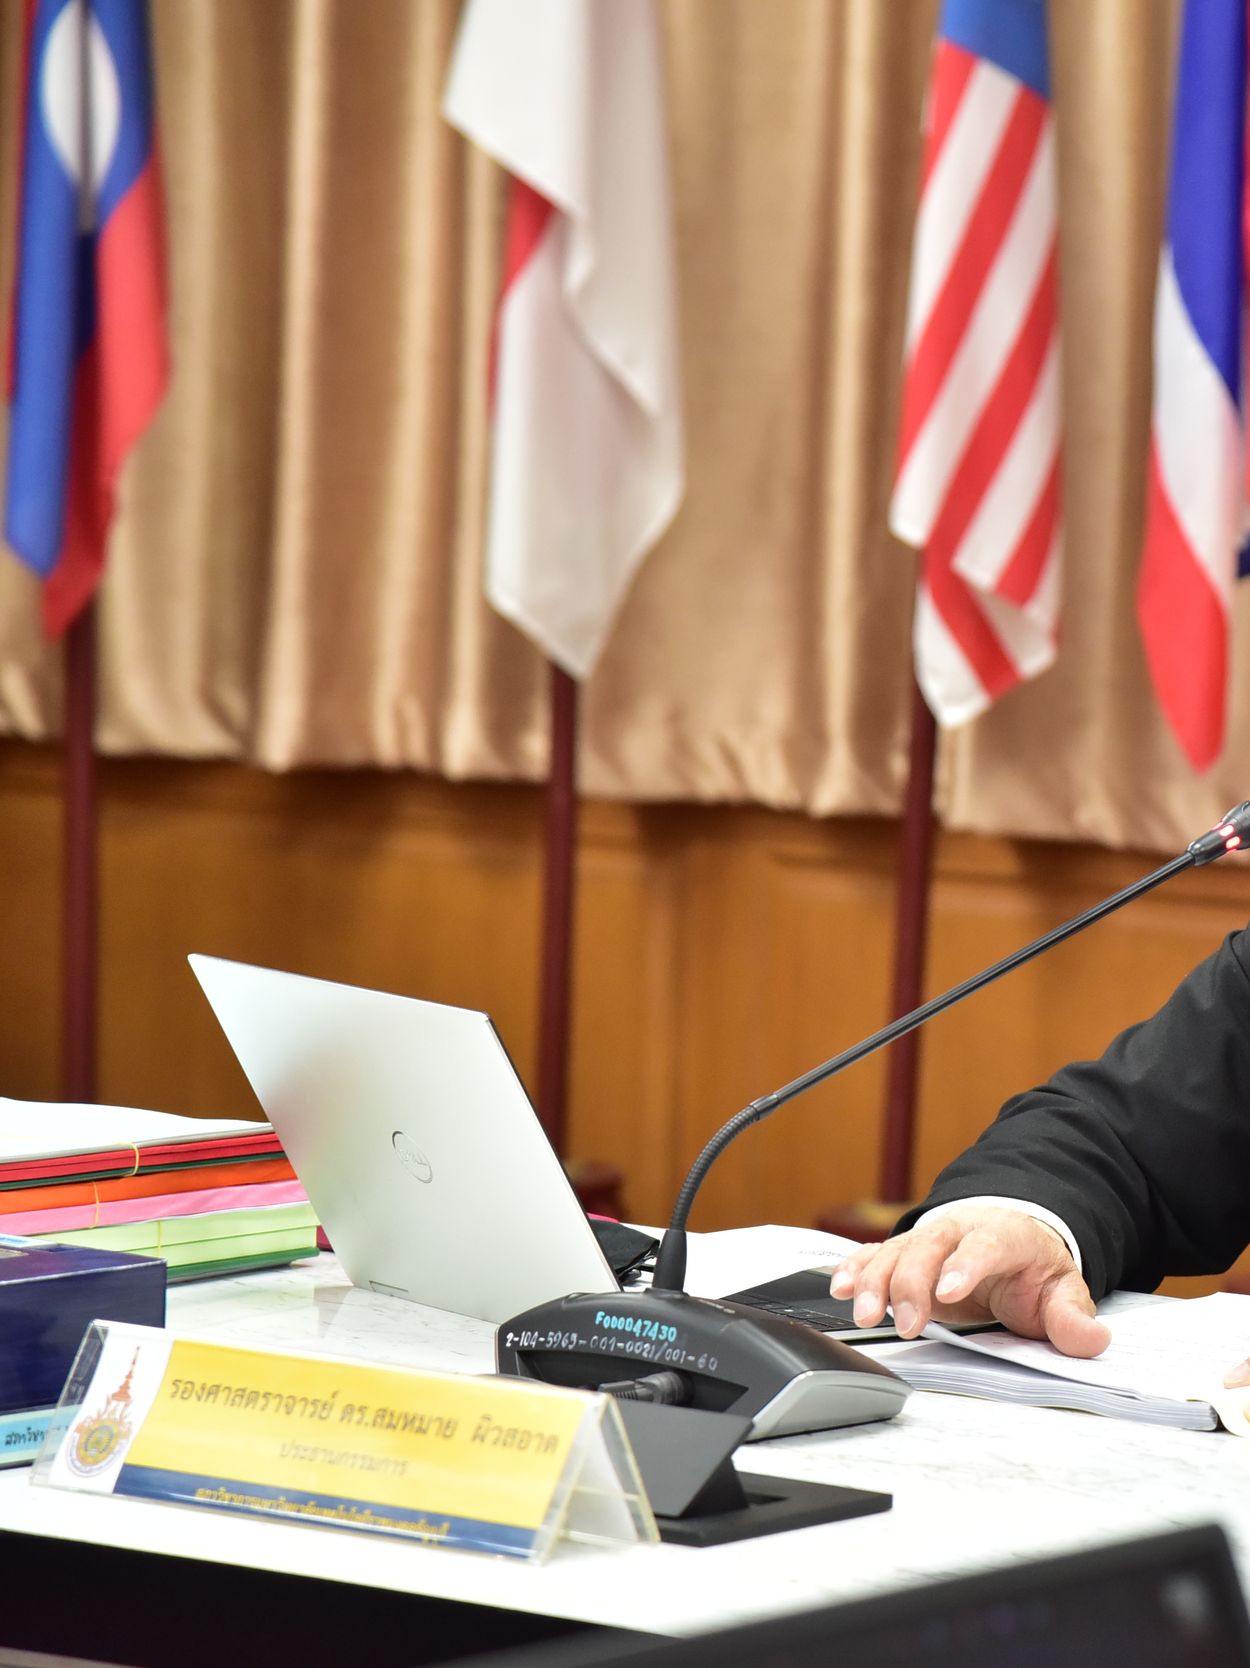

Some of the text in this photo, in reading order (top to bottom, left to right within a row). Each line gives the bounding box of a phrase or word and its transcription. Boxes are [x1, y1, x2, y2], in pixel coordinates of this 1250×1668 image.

[595, 1311, 677, 1342] F000047430
[170, 1378, 340, 1421] รองศาสตราจารย์
